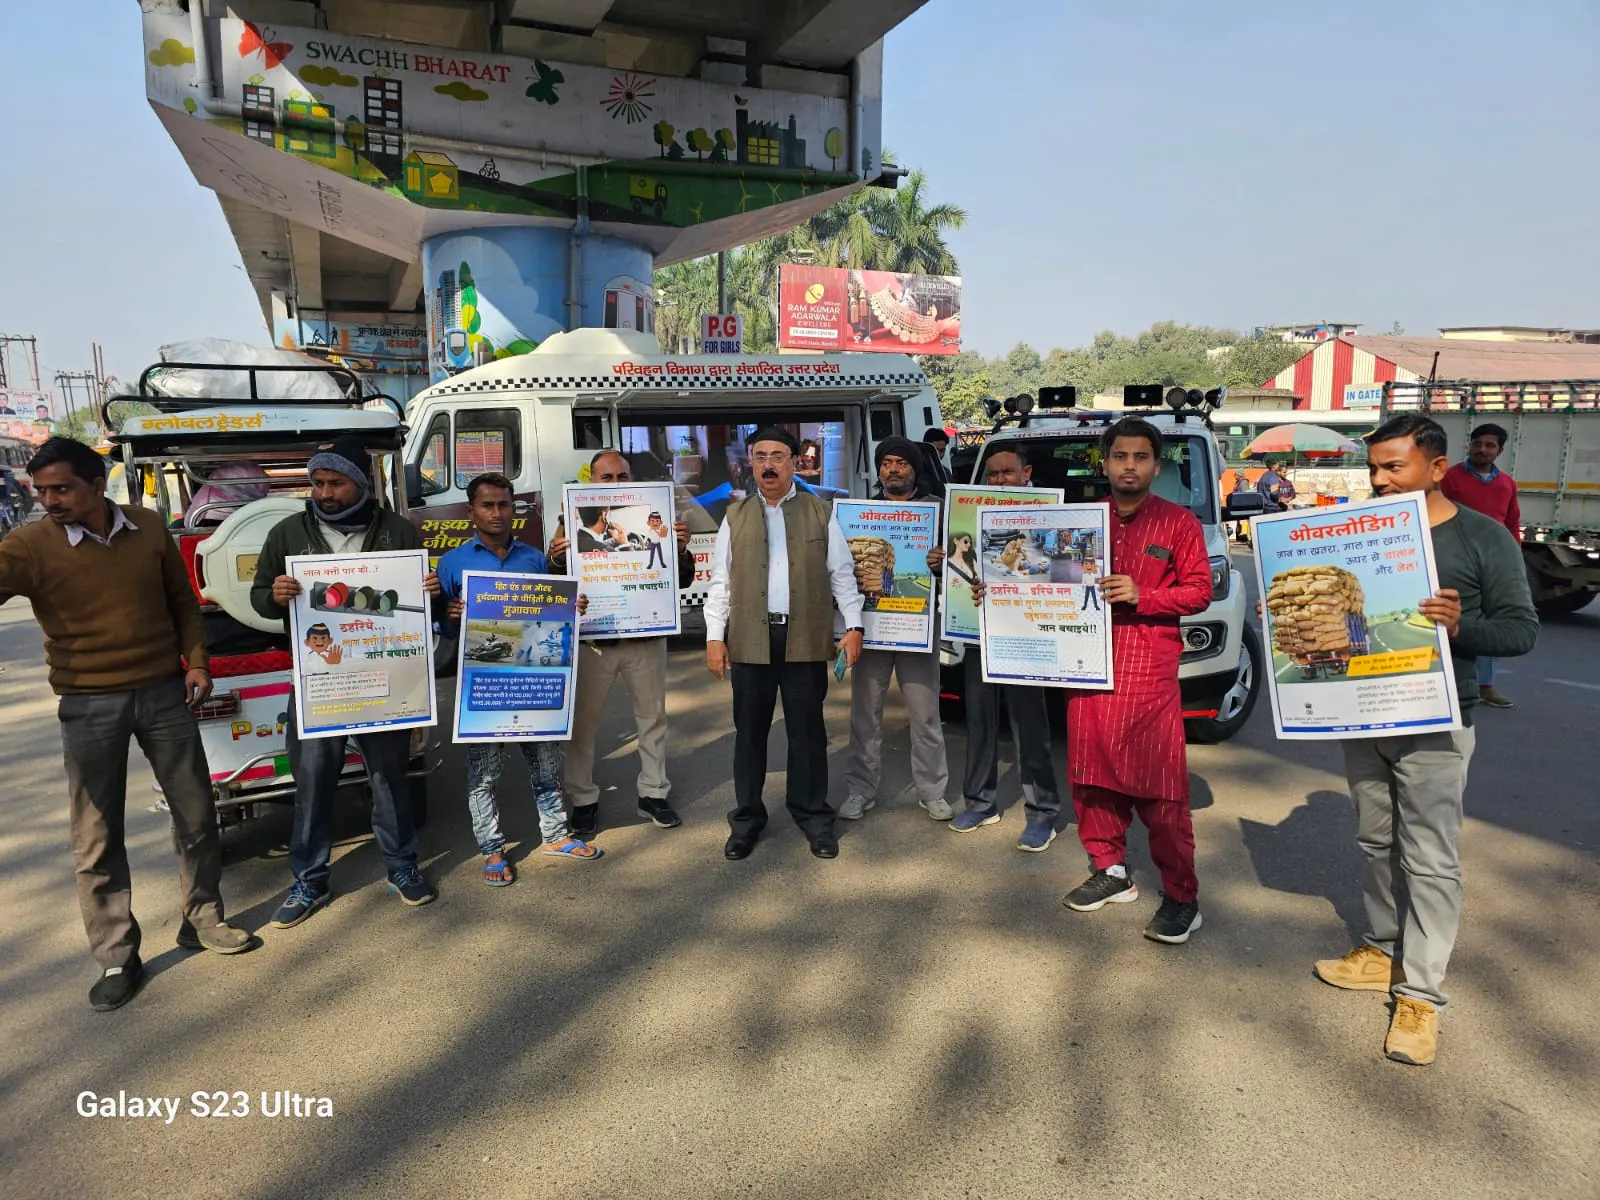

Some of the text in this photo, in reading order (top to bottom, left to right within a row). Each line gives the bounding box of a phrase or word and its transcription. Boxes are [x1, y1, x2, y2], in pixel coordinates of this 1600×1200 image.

[306, 41, 511, 83] SWACHH BHARAT
[788, 304, 841, 314] RAM KUMAR
[708, 316, 737, 338] P.G
[704, 341, 741, 354] FOR GIRLS
[612, 360, 841, 377] परिवहन विभाग द्वारा संचालित उत्तर प्रदेश
[1346, 389, 1382, 400] IN GATE
[421, 519, 472, 533] सड़क
[1276, 550, 1293, 559] जान
[1296, 548, 1307, 556] का
[1342, 541, 1363, 552] माल
[1367, 538, 1378, 548] का
[1344, 555, 1368, 566] ऊपर
[1371, 552, 1380, 562] से
[303, 568, 321, 578] लाल
[342, 566, 356, 576] पार
[1375, 566, 1394, 576] और
[621, 583, 637, 592] जान
[1037, 624, 1056, 634] जान
[364, 650, 384, 660] जान
